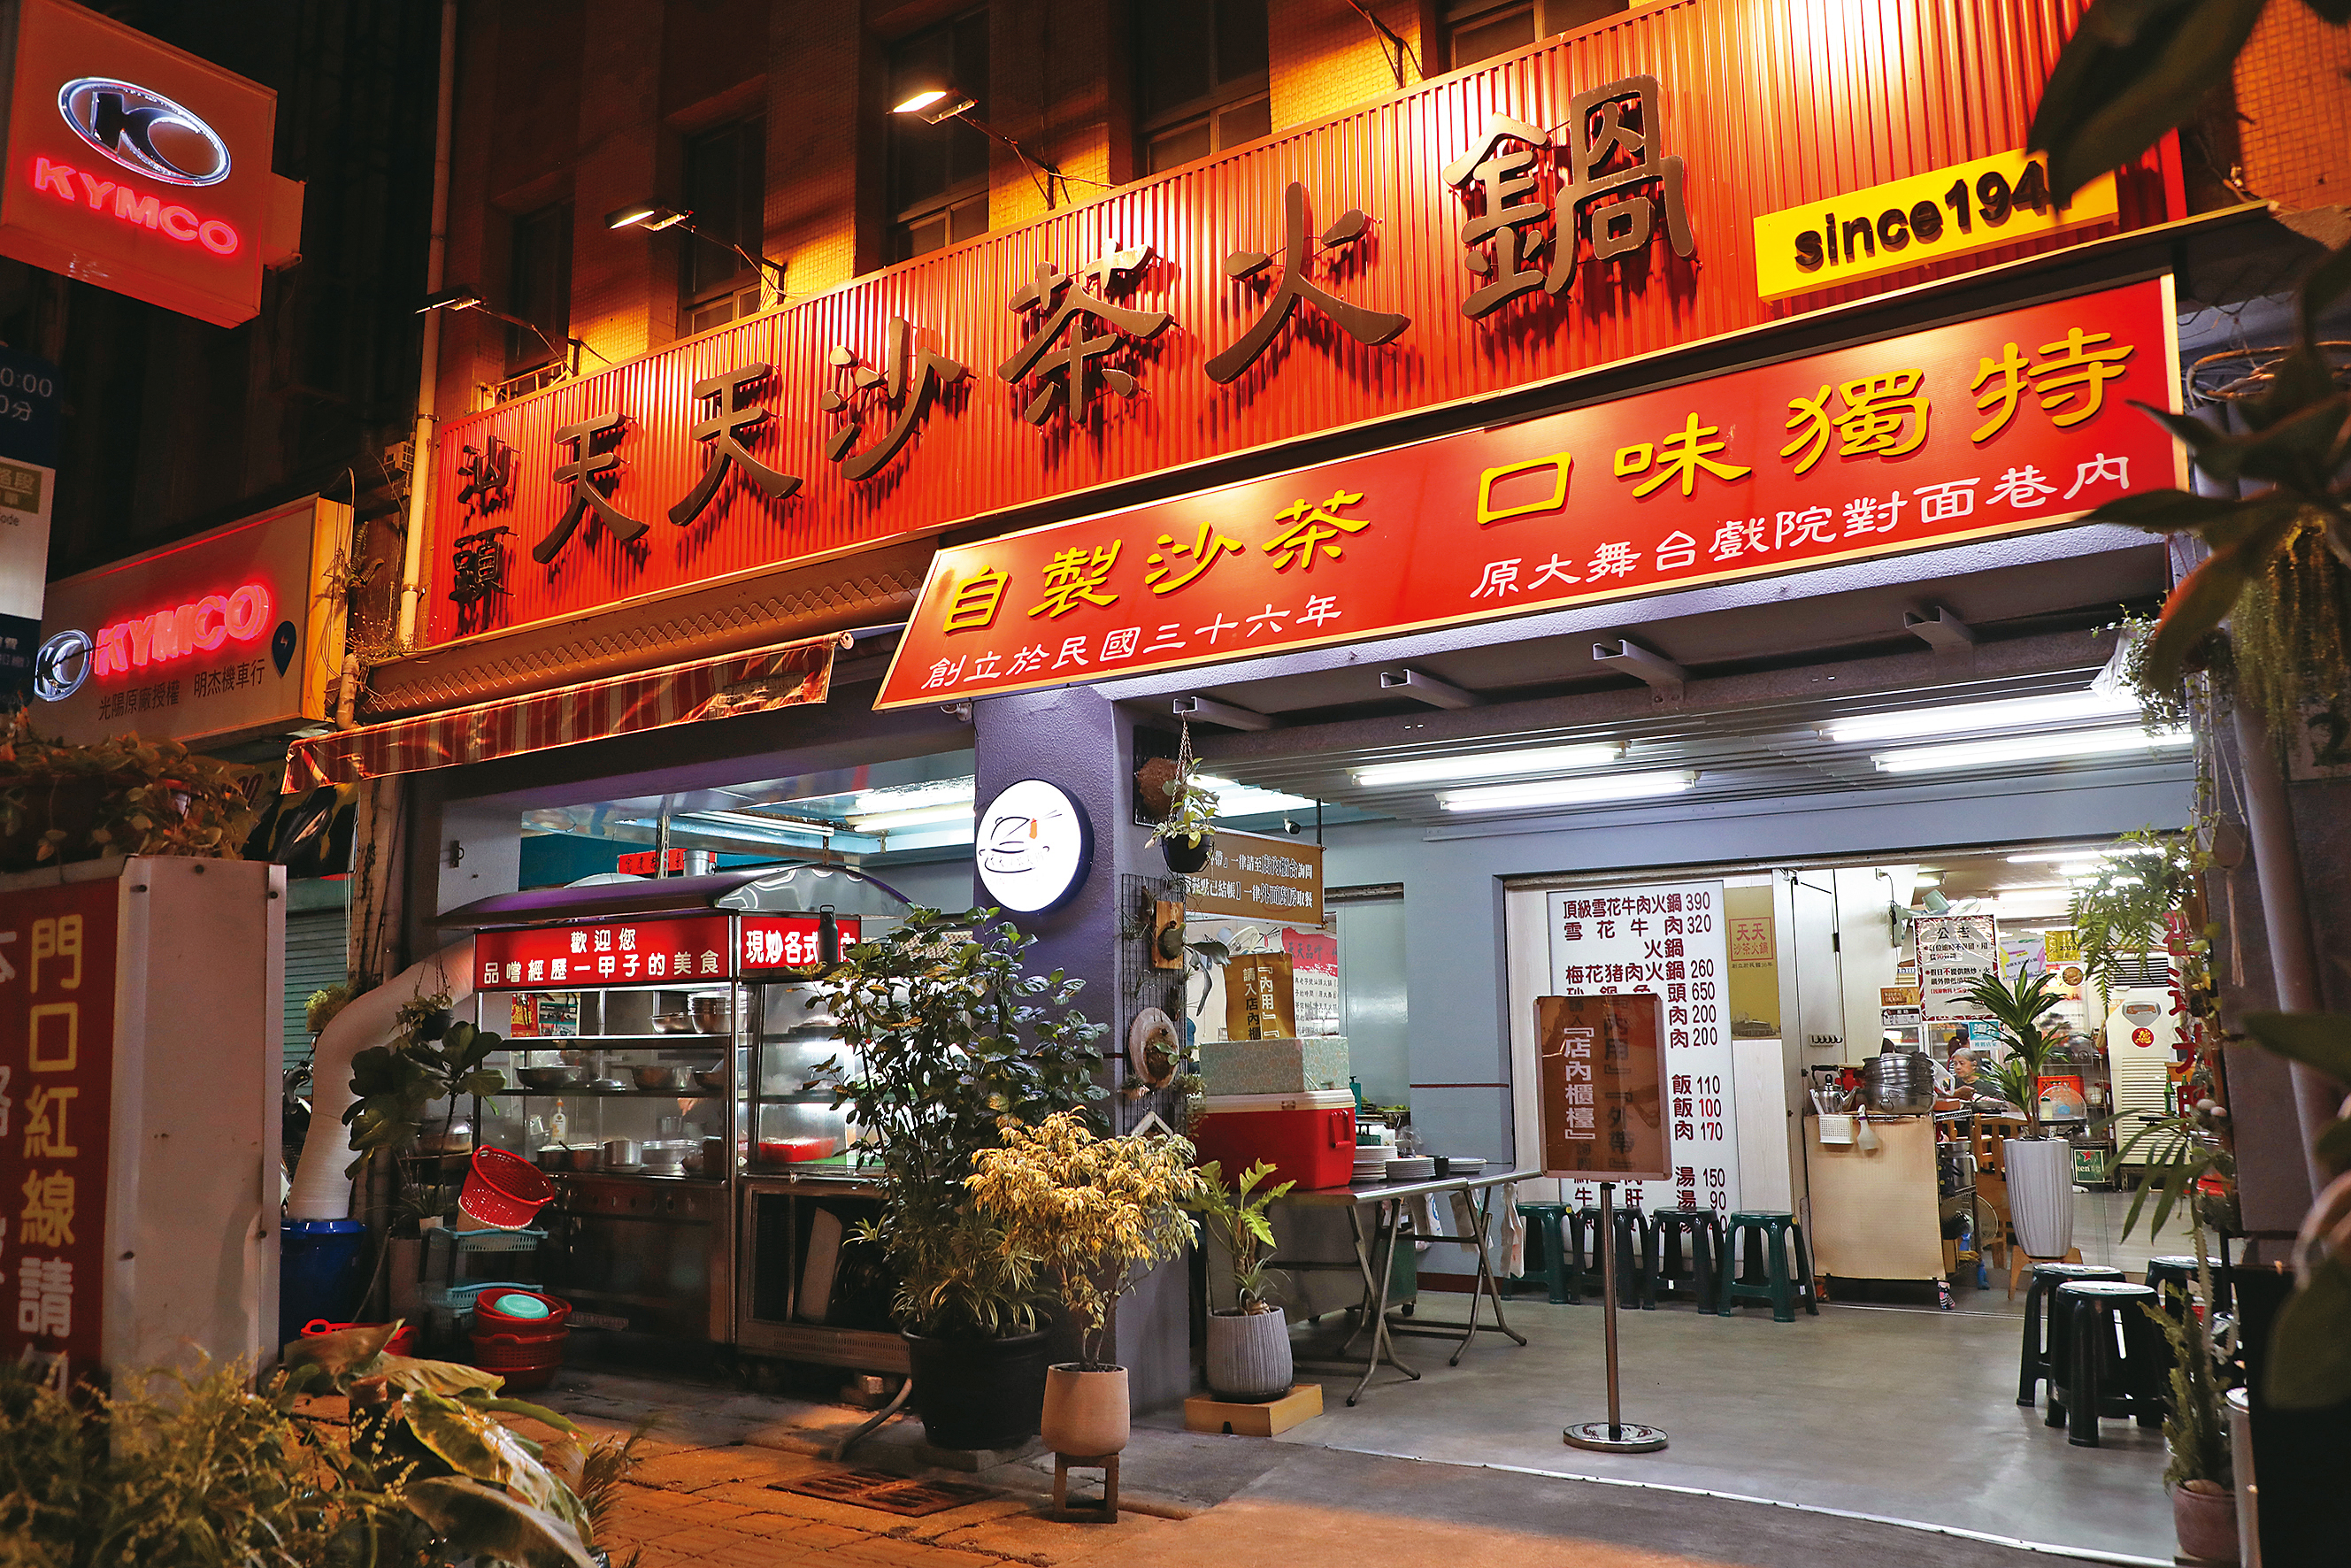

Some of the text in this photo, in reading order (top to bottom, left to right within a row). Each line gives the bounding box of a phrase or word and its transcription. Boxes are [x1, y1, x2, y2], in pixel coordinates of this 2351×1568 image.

[35, 158, 238, 255] KYMCO
[1794, 160, 2071, 273] since194
[533, 74, 1695, 565] 天天沙茶火鍋
[943, 327, 2134, 633] 自製沙茶 口味獨特
[449, 435, 511, 603] 汕頭
[921, 453, 2129, 690] 創立於民國三十六年 原大舞台戲院對面巷內
[95, 584, 269, 675] KYMCO
[98, 663, 265, 721] 光陽原廠授權 明杰機車行
[1563, 890, 1710, 919] 頂級雪花牛肉火鍋 390
[1686, 913, 1712, 934] 320
[1736, 923, 1766, 942] 天天
[570, 927, 637, 954] 歡迎您
[1644, 937, 1685, 959] 火鍋
[1733, 942, 1769, 956] 沙茶火鍋
[483, 949, 719, 985] 品嚐經歷一甲子的美食
[1565, 958, 1715, 985] 梅花猪肉火鍋 260
[1691, 980, 1716, 1002] 650
[1692, 1003, 1717, 1024] 200
[1693, 1026, 1718, 1047] 200
[1696, 1074, 1721, 1095] 110
[1698, 1097, 1722, 1118] 100
[1700, 1121, 1724, 1141] 170
[1702, 1167, 1726, 1188] 150
[1709, 1190, 1727, 1211] 90
